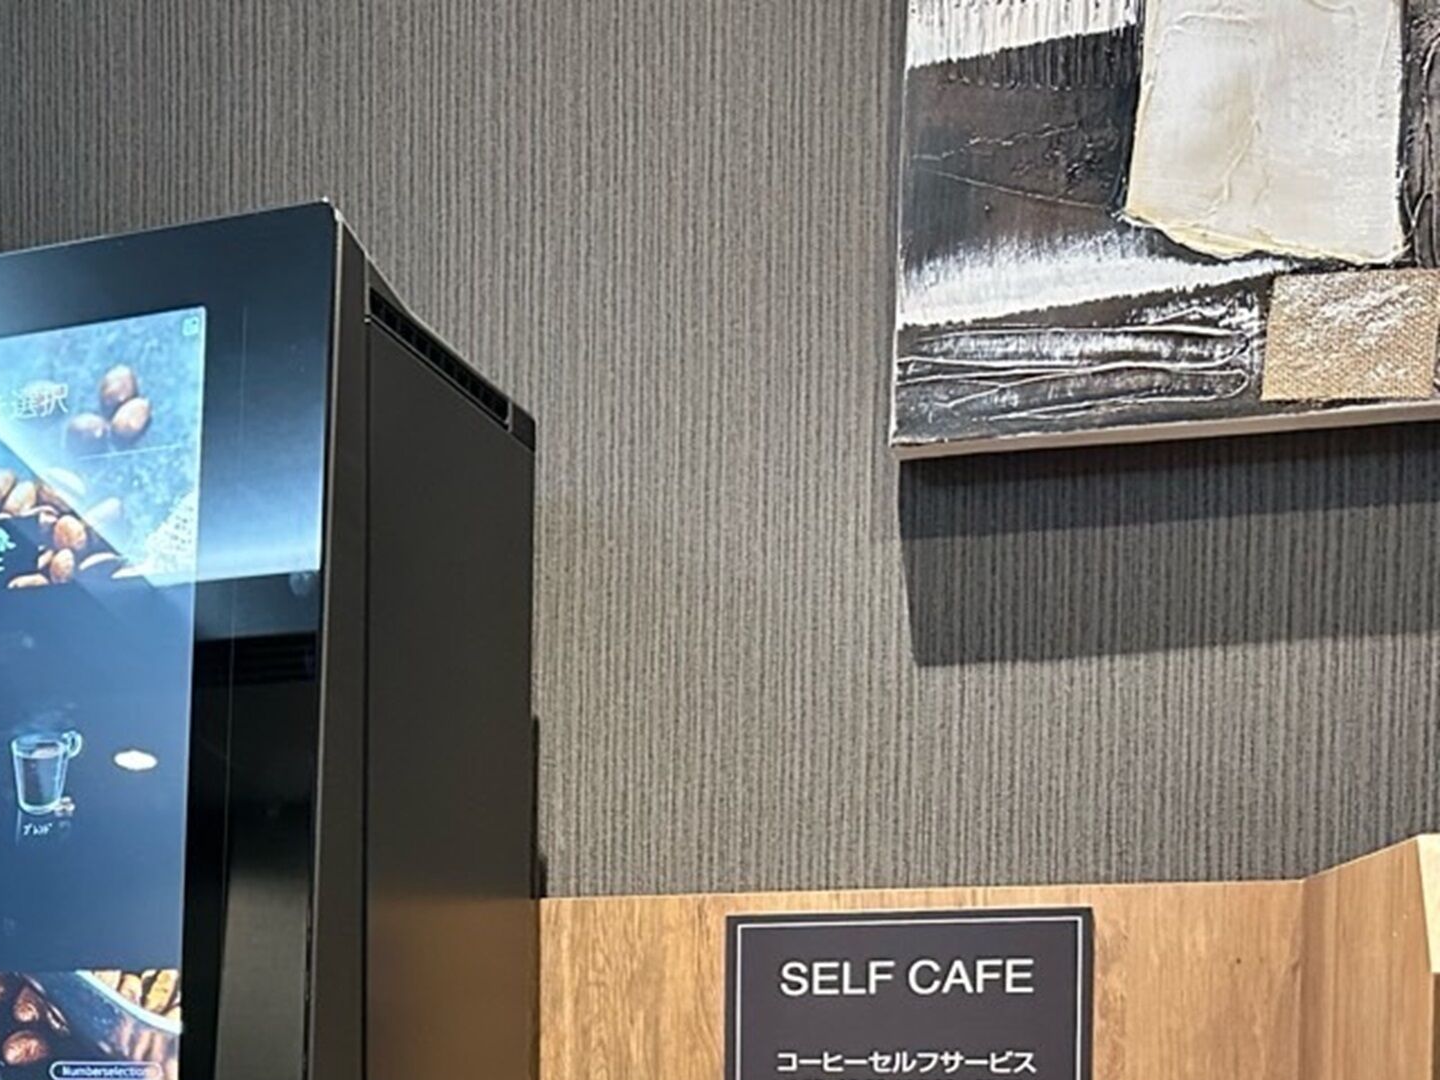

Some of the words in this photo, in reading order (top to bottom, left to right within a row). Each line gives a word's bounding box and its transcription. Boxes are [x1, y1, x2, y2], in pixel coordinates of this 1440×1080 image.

[780, 961, 895, 996] SELF
[908, 958, 1034, 994] CAFE
[777, 1050, 1037, 1074] コーヒーセルフサービス
